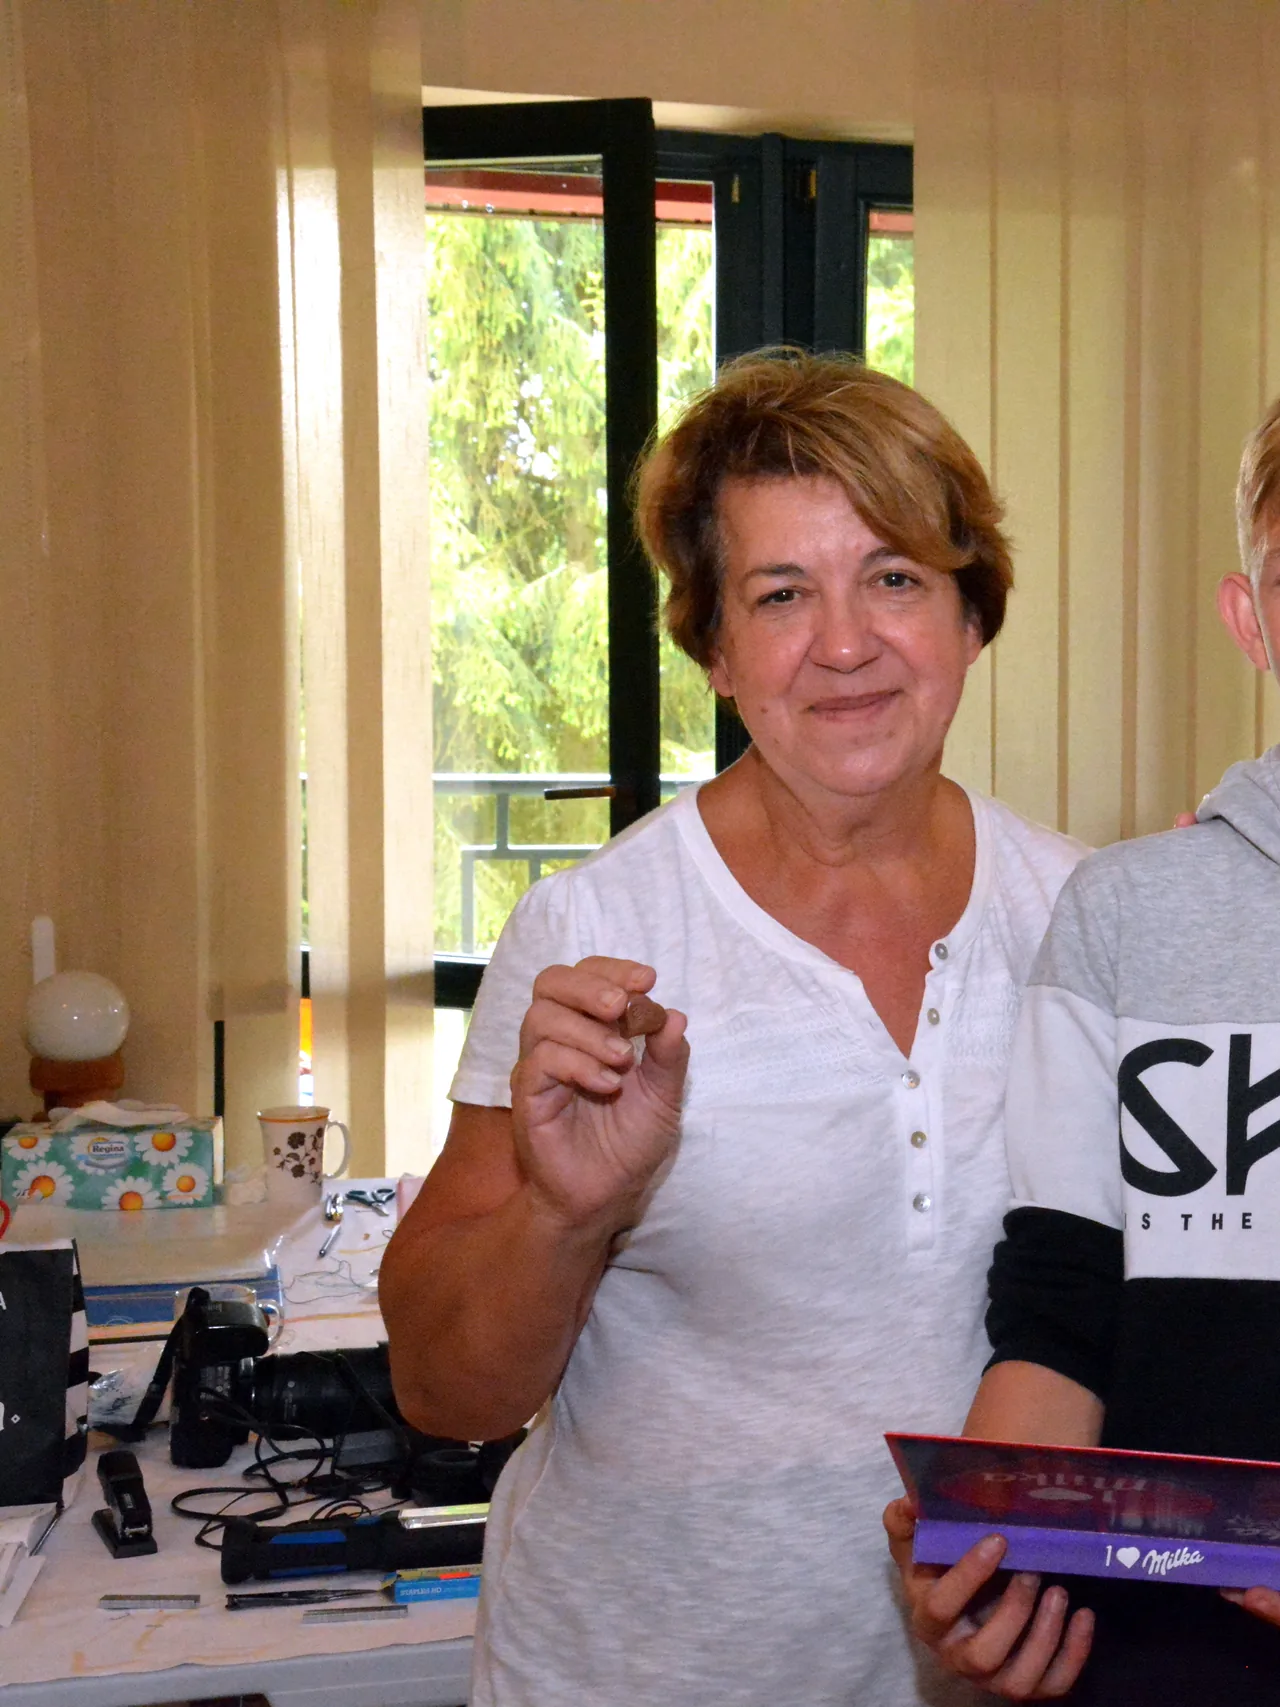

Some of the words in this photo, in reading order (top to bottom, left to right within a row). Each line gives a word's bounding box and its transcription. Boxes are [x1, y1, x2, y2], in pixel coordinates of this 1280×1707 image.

[92, 1144, 125, 1153] Regina
[1181, 1212, 1252, 1230] THE
[1105, 1545, 1112, 1567] I
[1142, 1546, 1204, 1576] Milka
